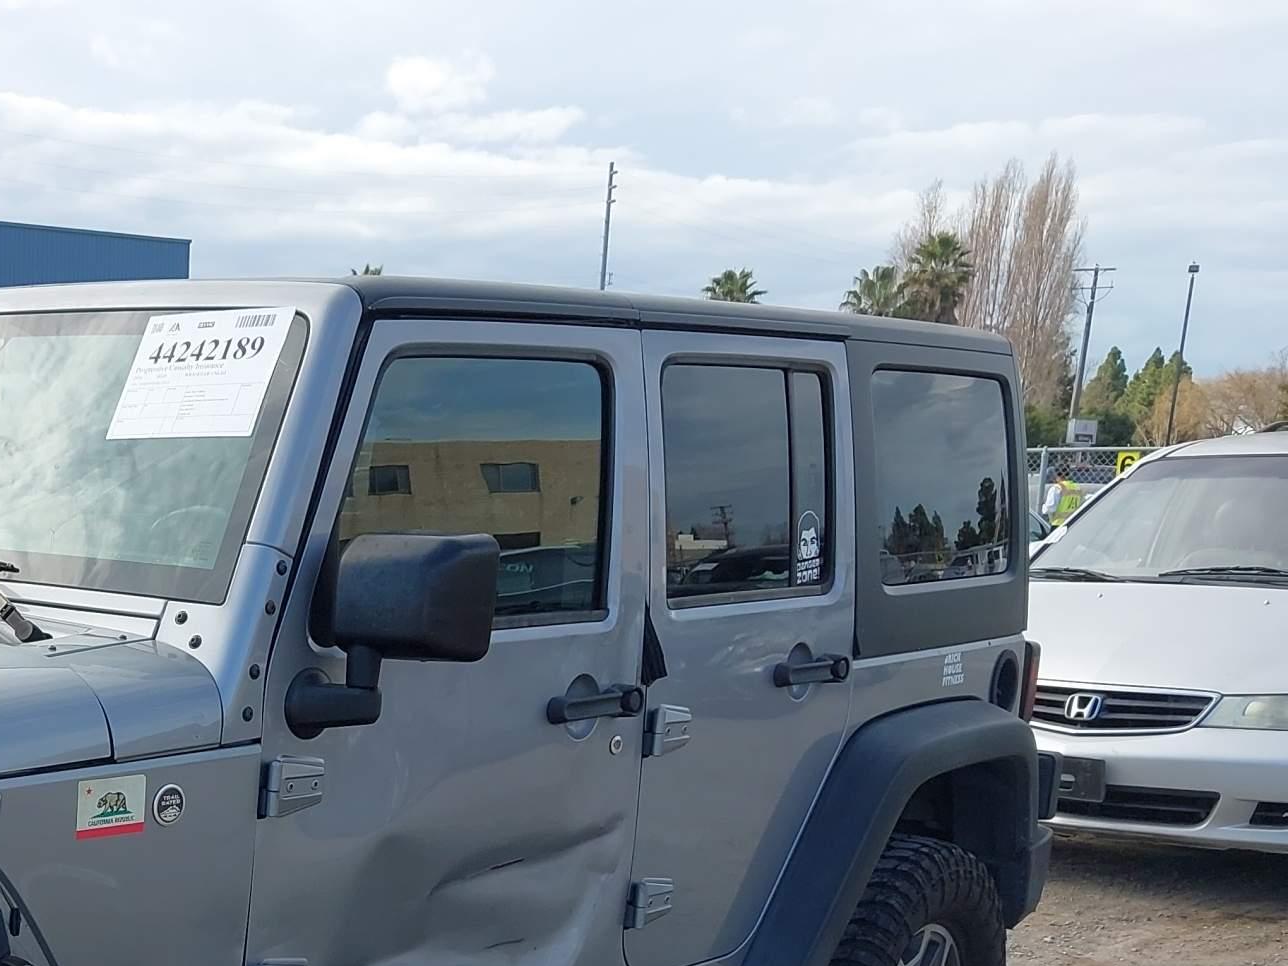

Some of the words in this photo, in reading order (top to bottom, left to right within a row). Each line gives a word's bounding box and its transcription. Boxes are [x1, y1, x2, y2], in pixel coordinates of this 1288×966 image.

[148, 335, 265, 364] 44242189
[87, 818, 114, 827] CALIFORNIA
[114, 815, 136, 823] REPUBLIC
